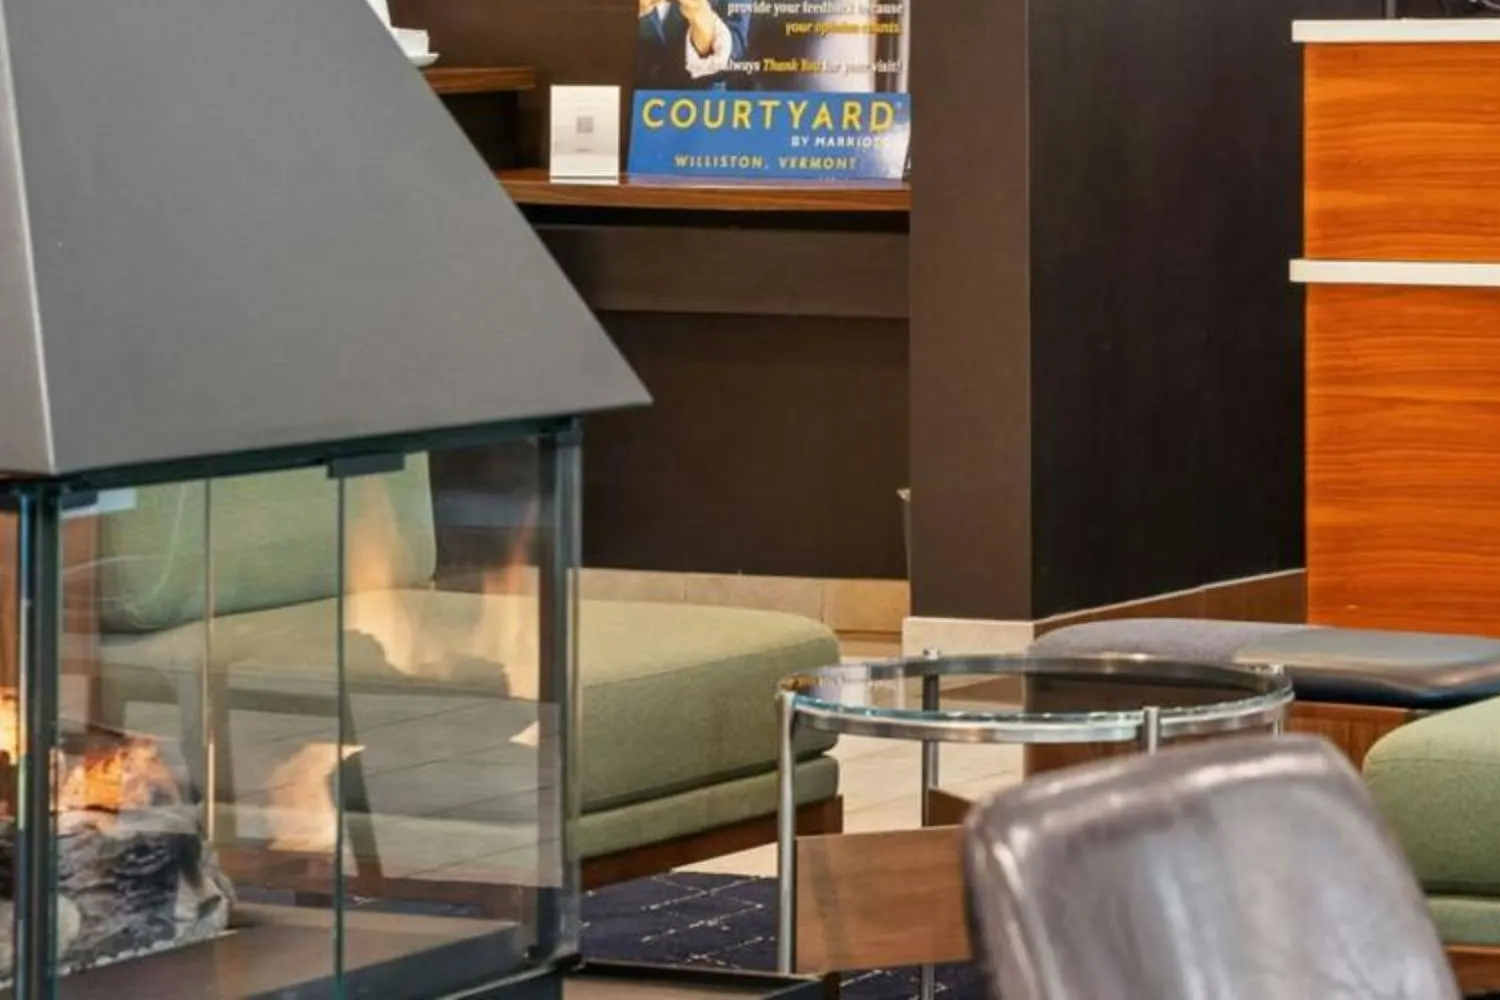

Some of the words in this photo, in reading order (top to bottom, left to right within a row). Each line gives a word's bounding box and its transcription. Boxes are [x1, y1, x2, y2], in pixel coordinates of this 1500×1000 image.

[728, 1, 772, 15] provide
[773, 2, 802, 18] your
[803, 0, 853, 14] feedbk
[785, 22, 814, 36] your
[726, 59, 761, 75] lways
[763, 57, 799, 72] Thank
[641, 98, 895, 132] COURTYARD
[791, 135, 809, 148] BY
[814, 136, 885, 150] MARRIO
[778, 155, 857, 170] VERMONT
